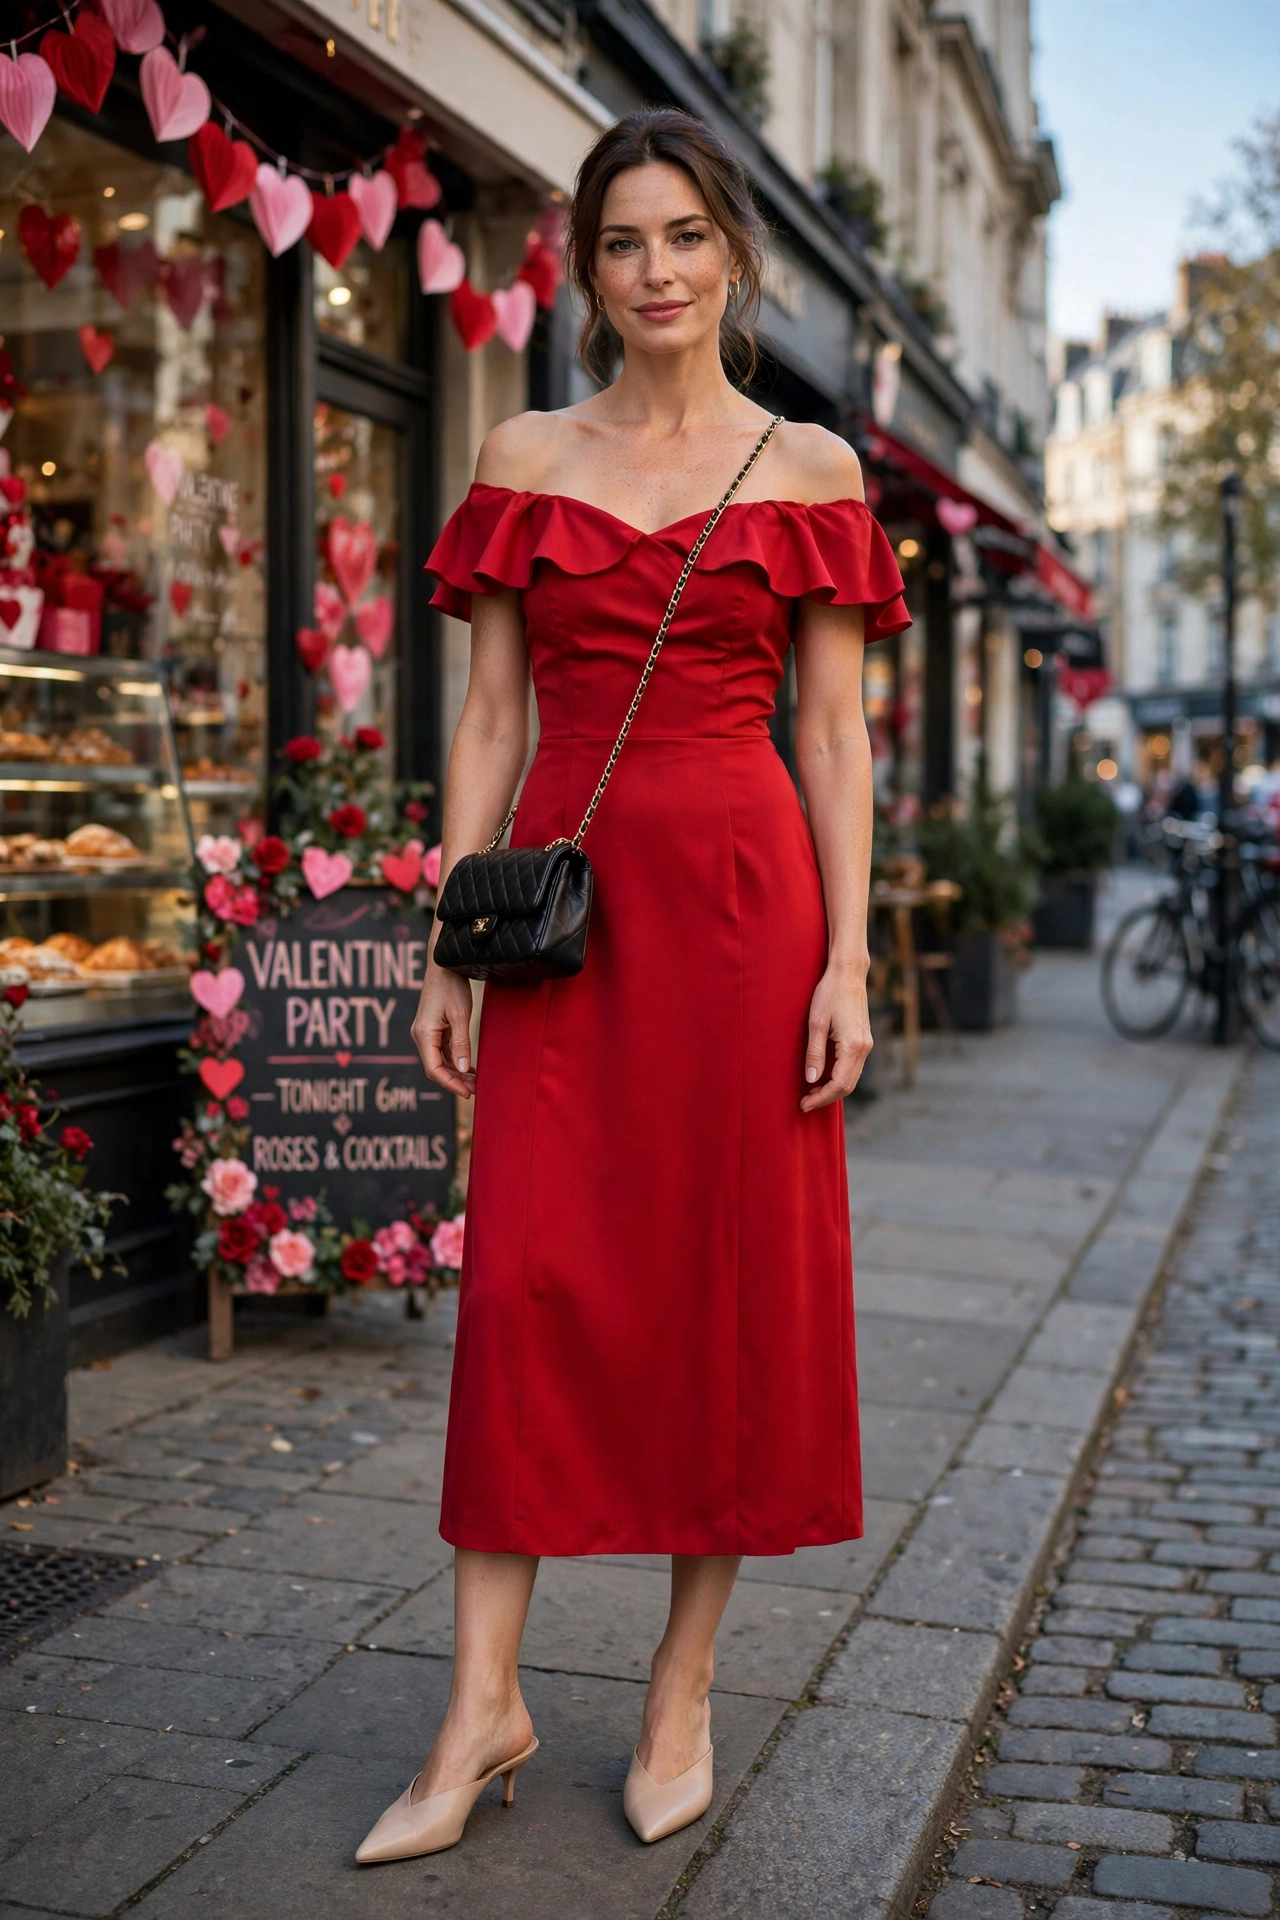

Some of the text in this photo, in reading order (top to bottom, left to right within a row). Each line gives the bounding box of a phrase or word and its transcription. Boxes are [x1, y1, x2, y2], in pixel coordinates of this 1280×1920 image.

[246, 940, 424, 990] VALENTINE
[286, 996, 396, 1047] PARTY
[275, 1078, 368, 1114] TONIGHT
[253, 1135, 447, 1172] ROSES & COCKTAILS
